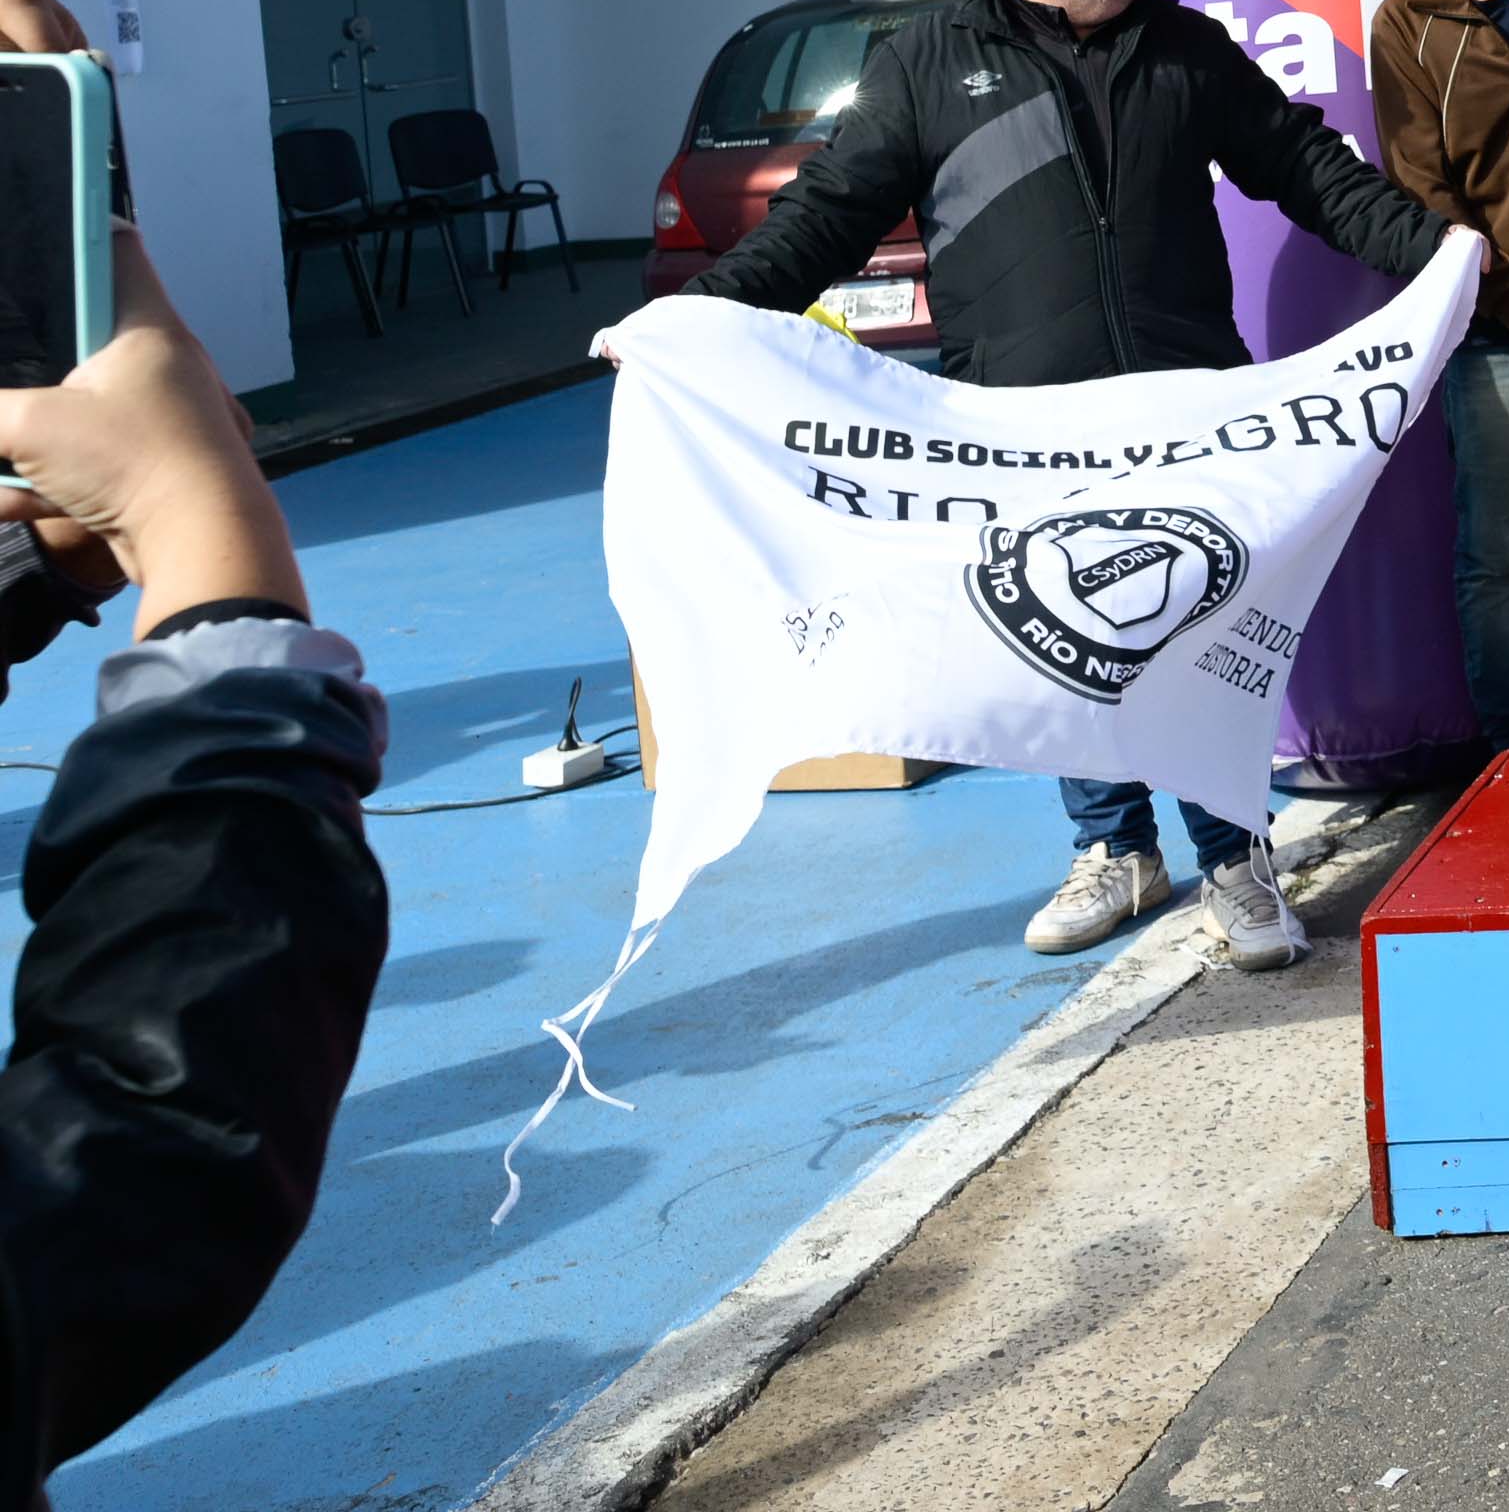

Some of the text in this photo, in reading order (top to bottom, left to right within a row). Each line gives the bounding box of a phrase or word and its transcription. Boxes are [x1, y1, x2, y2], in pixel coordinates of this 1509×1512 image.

[784, 420, 914, 460] CLUB
[926, 439, 1112, 469] SOCIAL
[1077, 543, 1167, 589] CSyDRN
[1142, 509, 1235, 618] DEPORTIV
